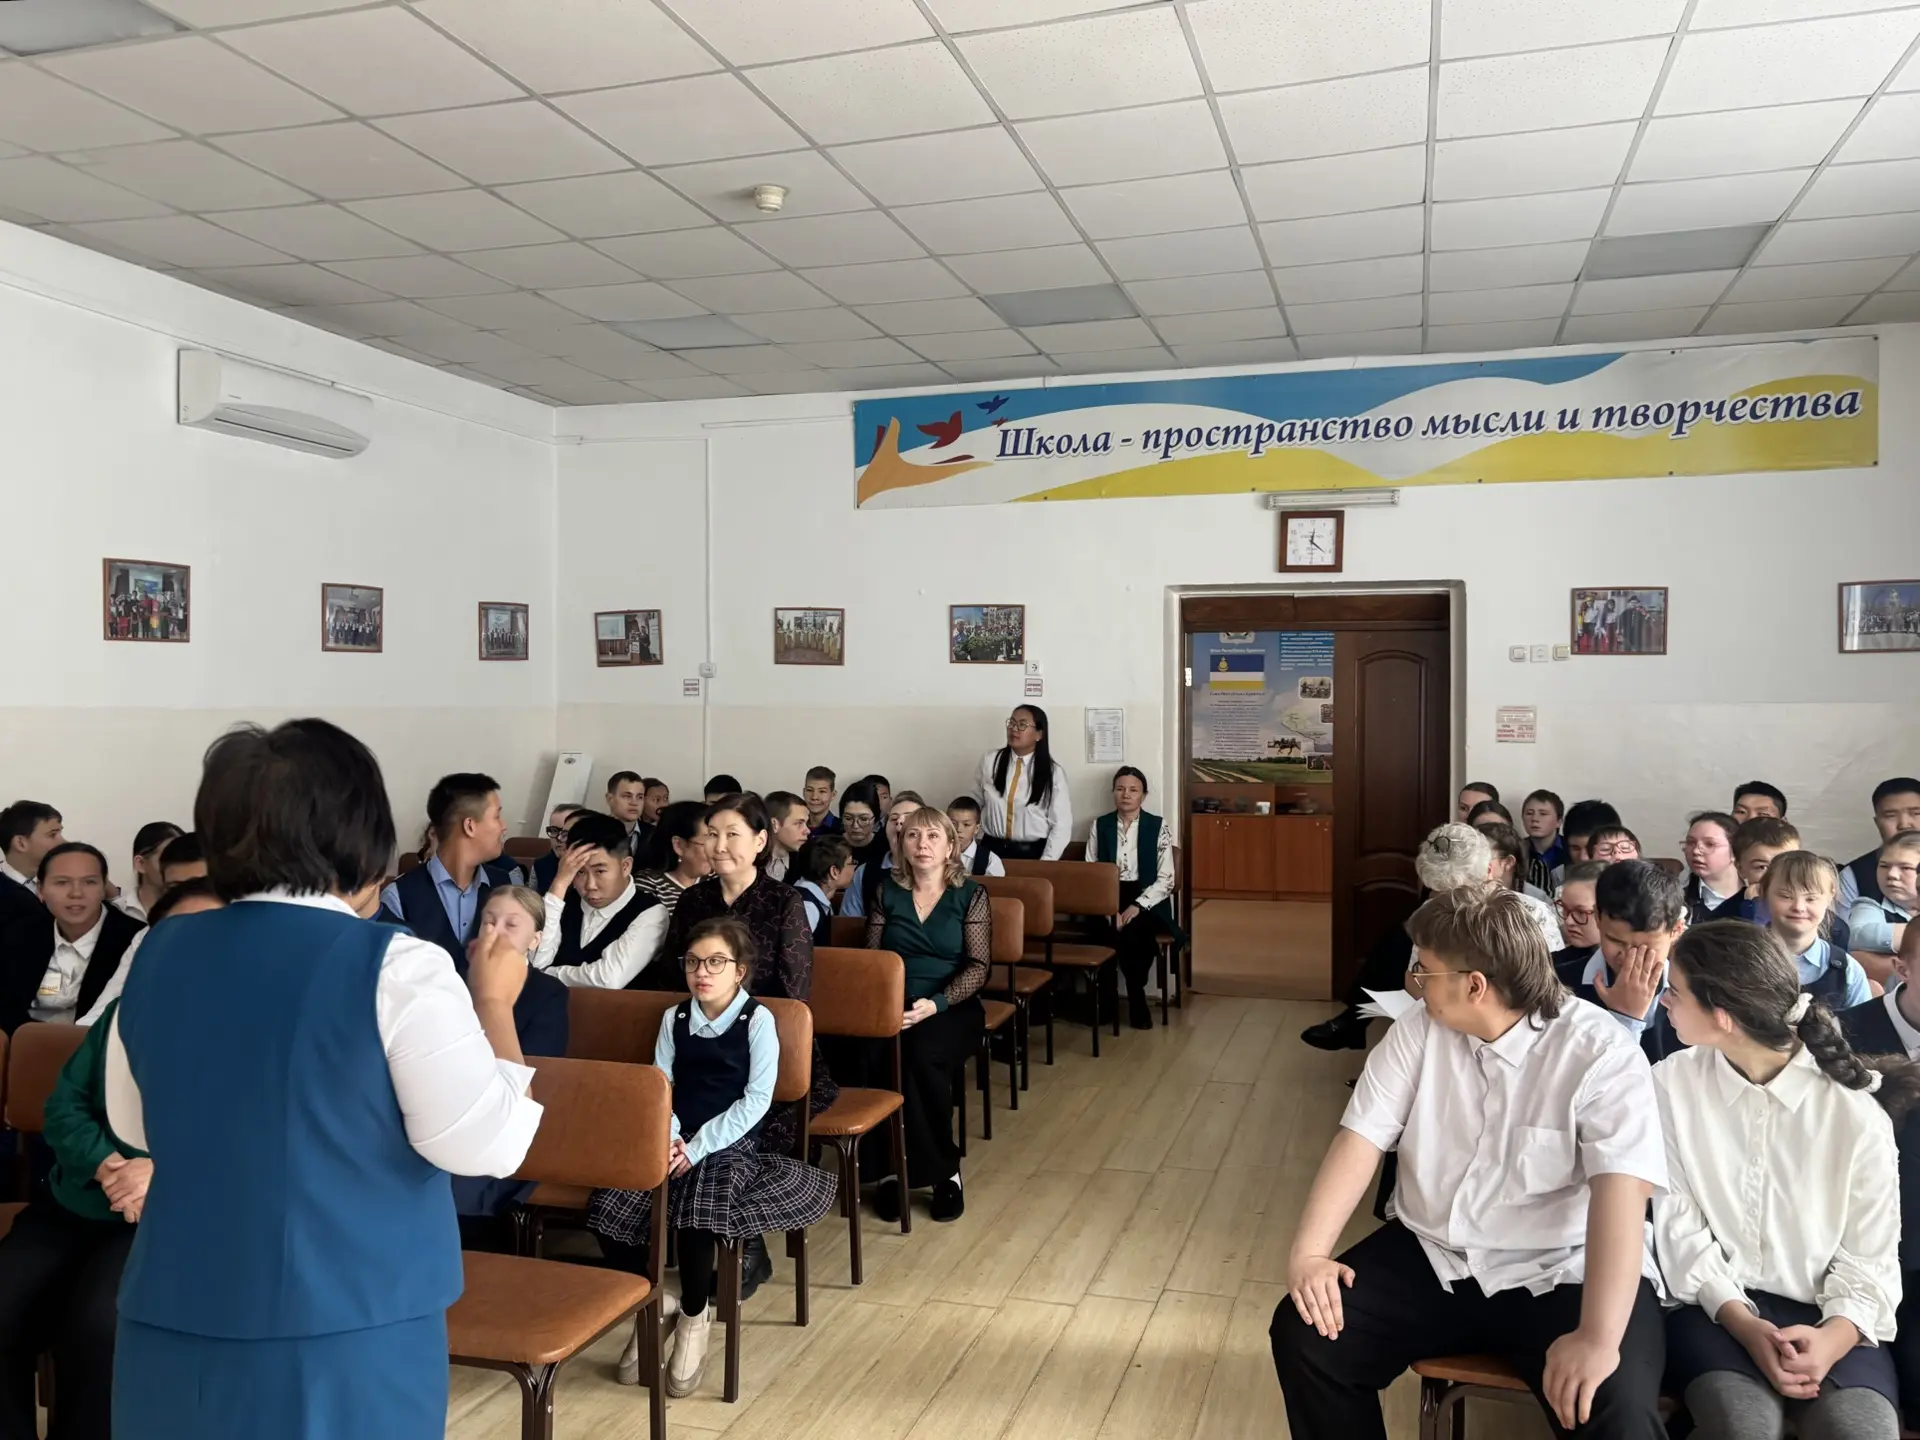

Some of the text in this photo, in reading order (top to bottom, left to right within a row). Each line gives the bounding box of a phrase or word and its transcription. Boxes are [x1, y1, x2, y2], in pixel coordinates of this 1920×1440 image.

[997, 425, 1113, 458] Школа
[1142, 409, 1414, 458] пространство
[1421, 406, 1546, 438] мысли
[1557, 406, 1581, 431] и
[1592, 389, 1862, 435] творчества
